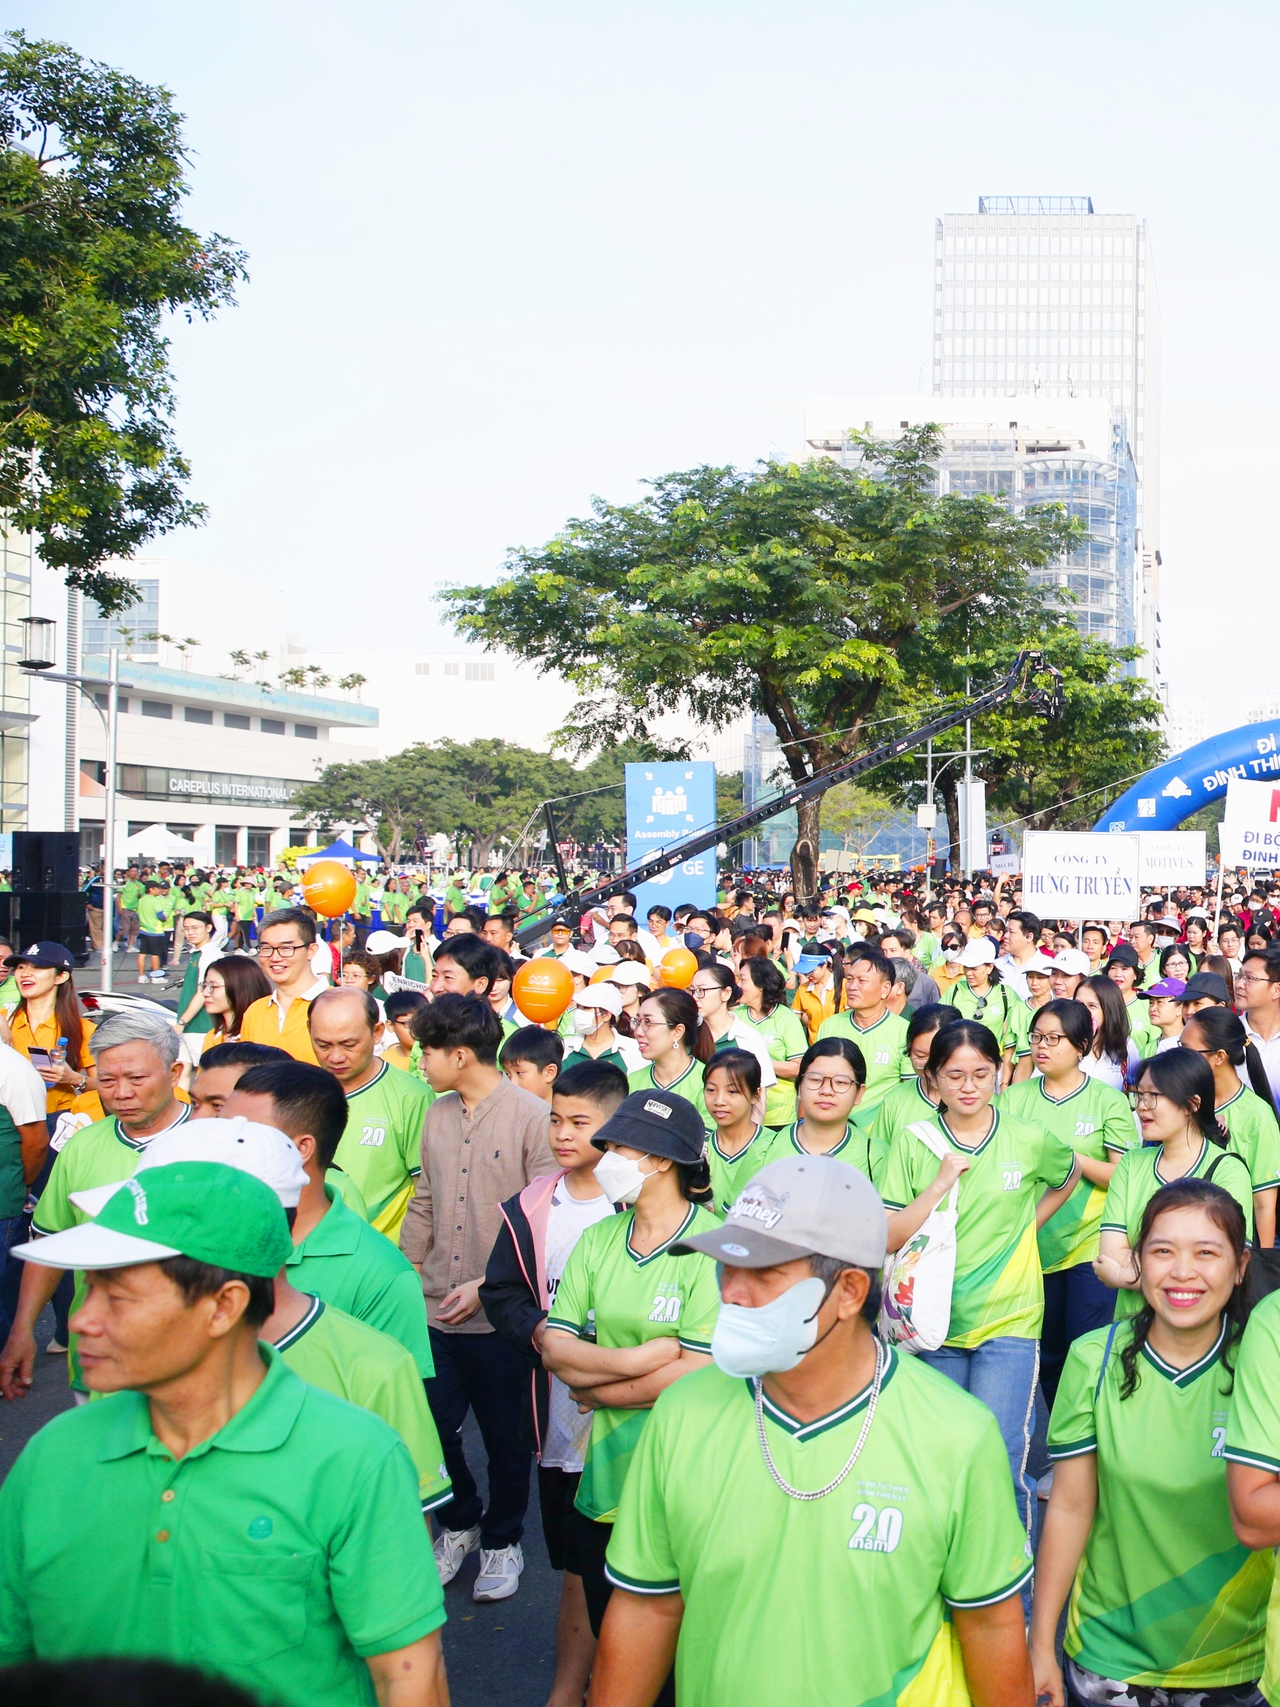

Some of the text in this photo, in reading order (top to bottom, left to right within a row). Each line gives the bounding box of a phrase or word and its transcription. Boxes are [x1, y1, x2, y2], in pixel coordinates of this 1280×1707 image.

[170, 778, 220, 794] CAREPLUS
[222, 783, 289, 800] INTERNATIONAL
[634, 828, 706, 840] Assembly Point
[1244, 831, 1260, 844] ĐI
[1054, 852, 1110, 864] CÔNG TY
[1145, 857, 1194, 868] MOTIVES
[1242, 850, 1278, 863] ĐINH
[682, 860, 704, 876] GE
[1030, 867, 1133, 896] HƯNG TRUYỀN
[874, 1051, 890, 1064] 20
[360, 1126, 386, 1147] 20
[1074, 1122, 1095, 1136] 20
[1002, 1170, 1022, 1191] 20
[648, 1295, 682, 1322] 20
[848, 1502, 904, 1554] 20
[853, 1535, 888, 1552] năm
